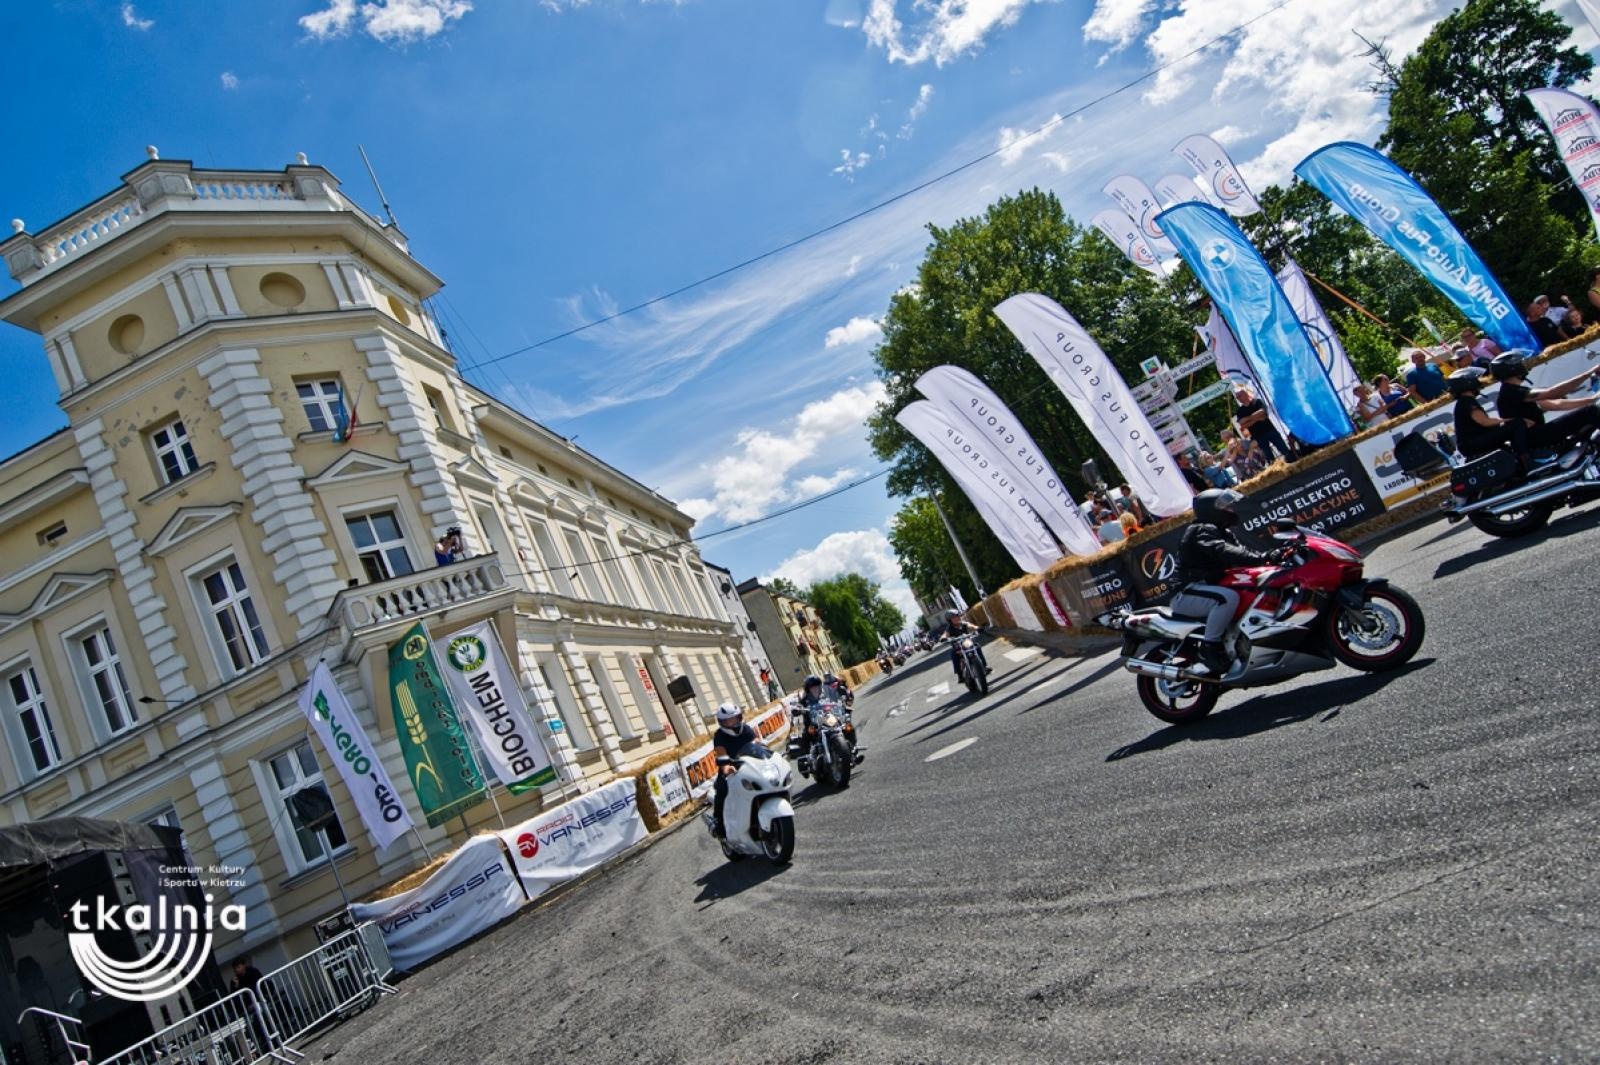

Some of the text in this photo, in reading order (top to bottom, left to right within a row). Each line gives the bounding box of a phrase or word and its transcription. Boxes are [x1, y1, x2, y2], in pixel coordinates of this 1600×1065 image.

[1243, 477, 1352, 532] USŁUGI ELEKTRO
[1327, 511, 1347, 526] 709
[1351, 503, 1366, 517] 211
[469, 670, 536, 776] BIOCHEM
[536, 813, 574, 835] RADIO
[379, 862, 504, 934] VANESSA
